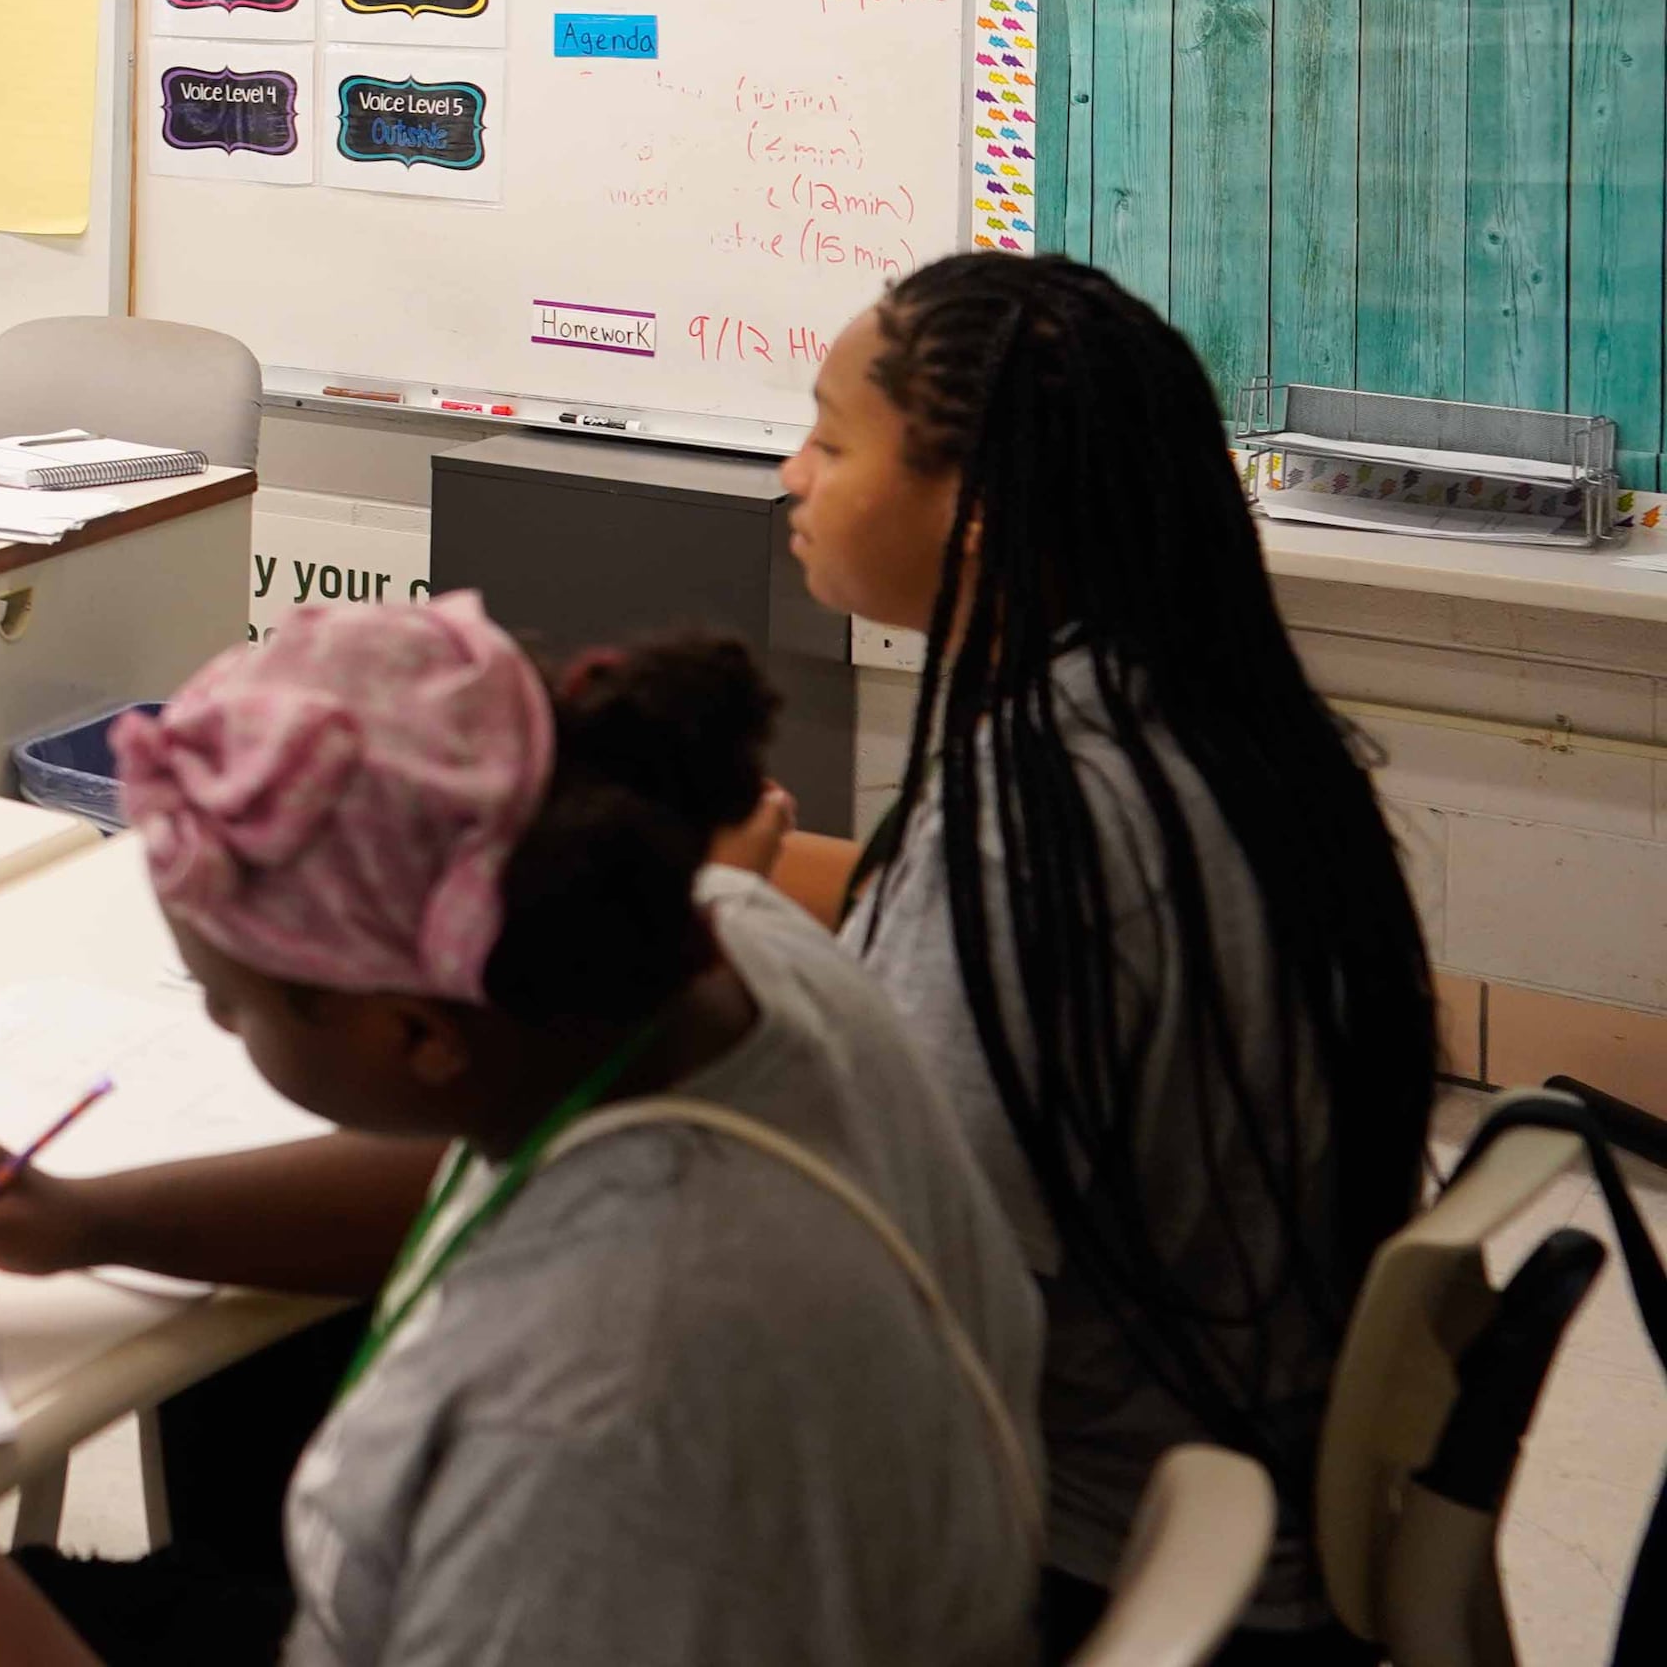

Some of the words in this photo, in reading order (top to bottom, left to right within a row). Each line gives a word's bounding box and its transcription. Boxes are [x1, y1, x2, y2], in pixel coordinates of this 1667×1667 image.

[563, 21, 656, 56] Agenda
[180, 82, 222, 102] Voice
[225, 84, 265, 104] Level
[267, 86, 277, 104] 4
[359, 92, 404, 113] Voice
[408, 95, 450, 116] Level
[453, 97, 463, 116] 5
[542, 309, 654, 348] Homework
[689, 315, 774, 364] 9/12
[294, 560, 392, 606] your
